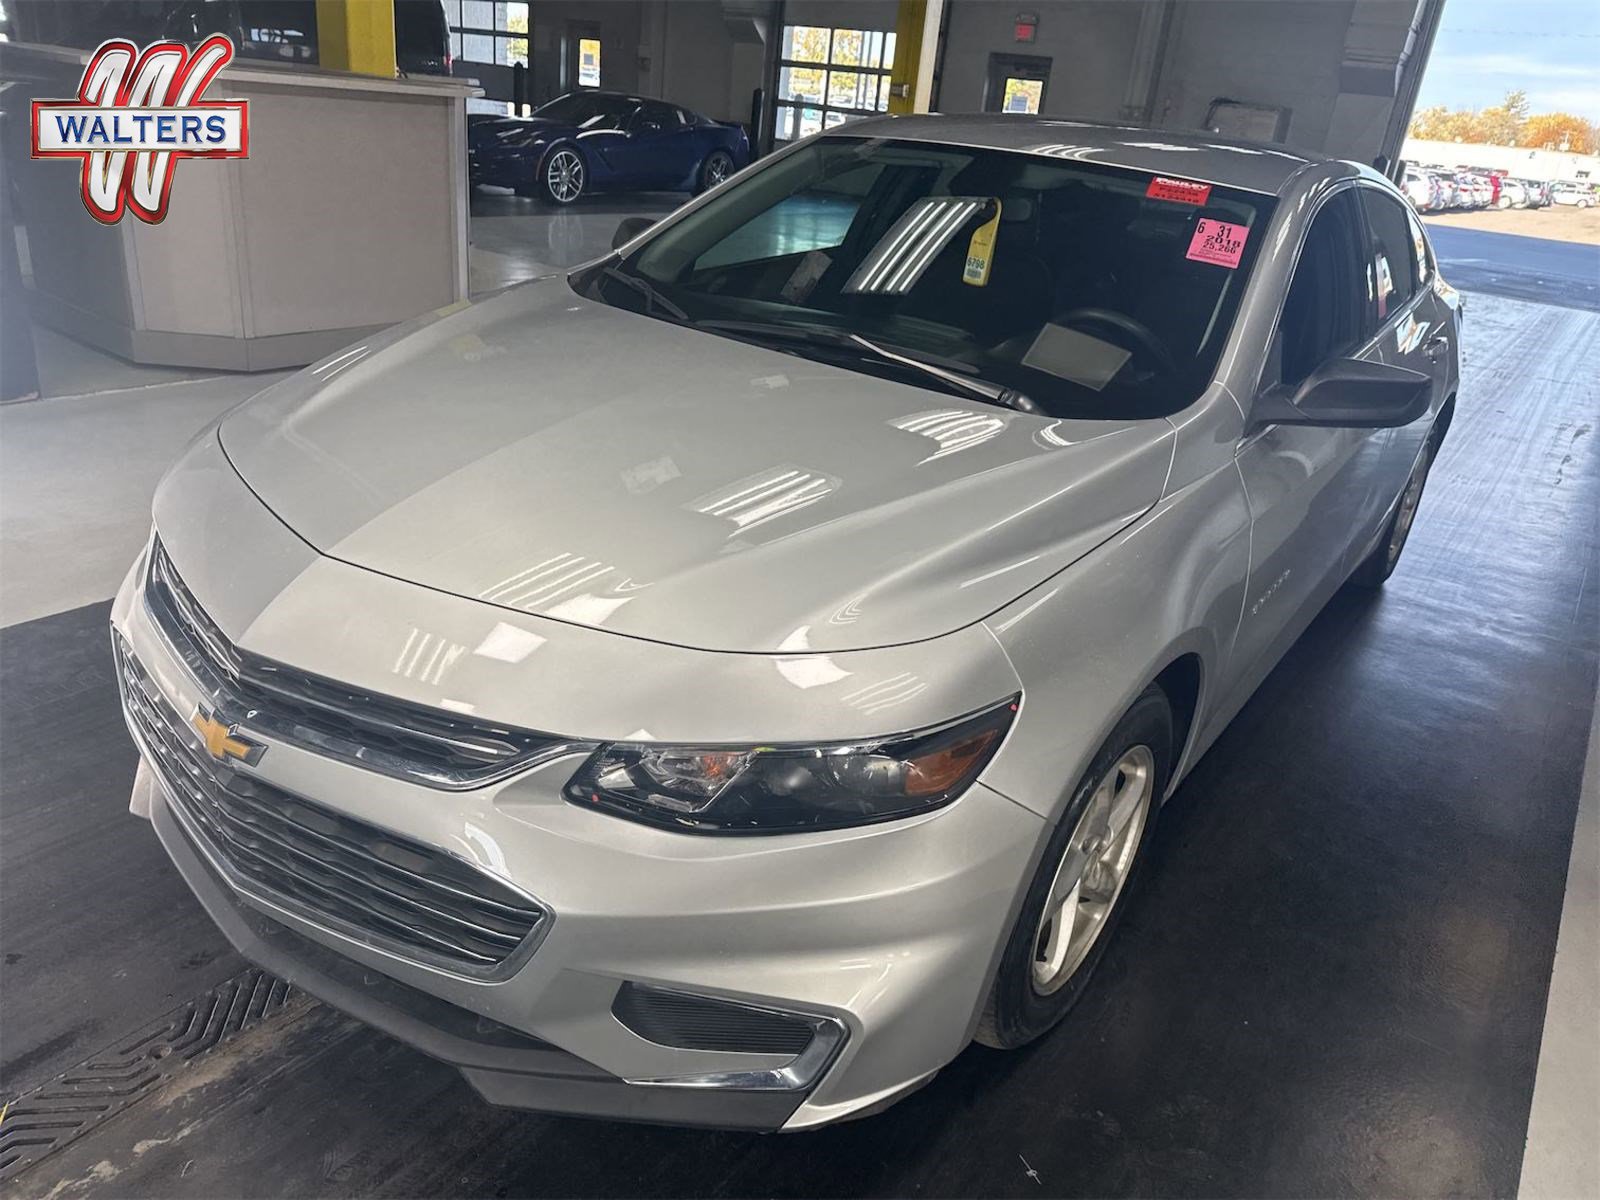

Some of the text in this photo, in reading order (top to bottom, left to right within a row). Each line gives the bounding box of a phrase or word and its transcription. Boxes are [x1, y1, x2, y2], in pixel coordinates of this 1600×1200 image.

[1197, 221, 1232, 239] 6 31
[1206, 235, 1241, 248] 2018
